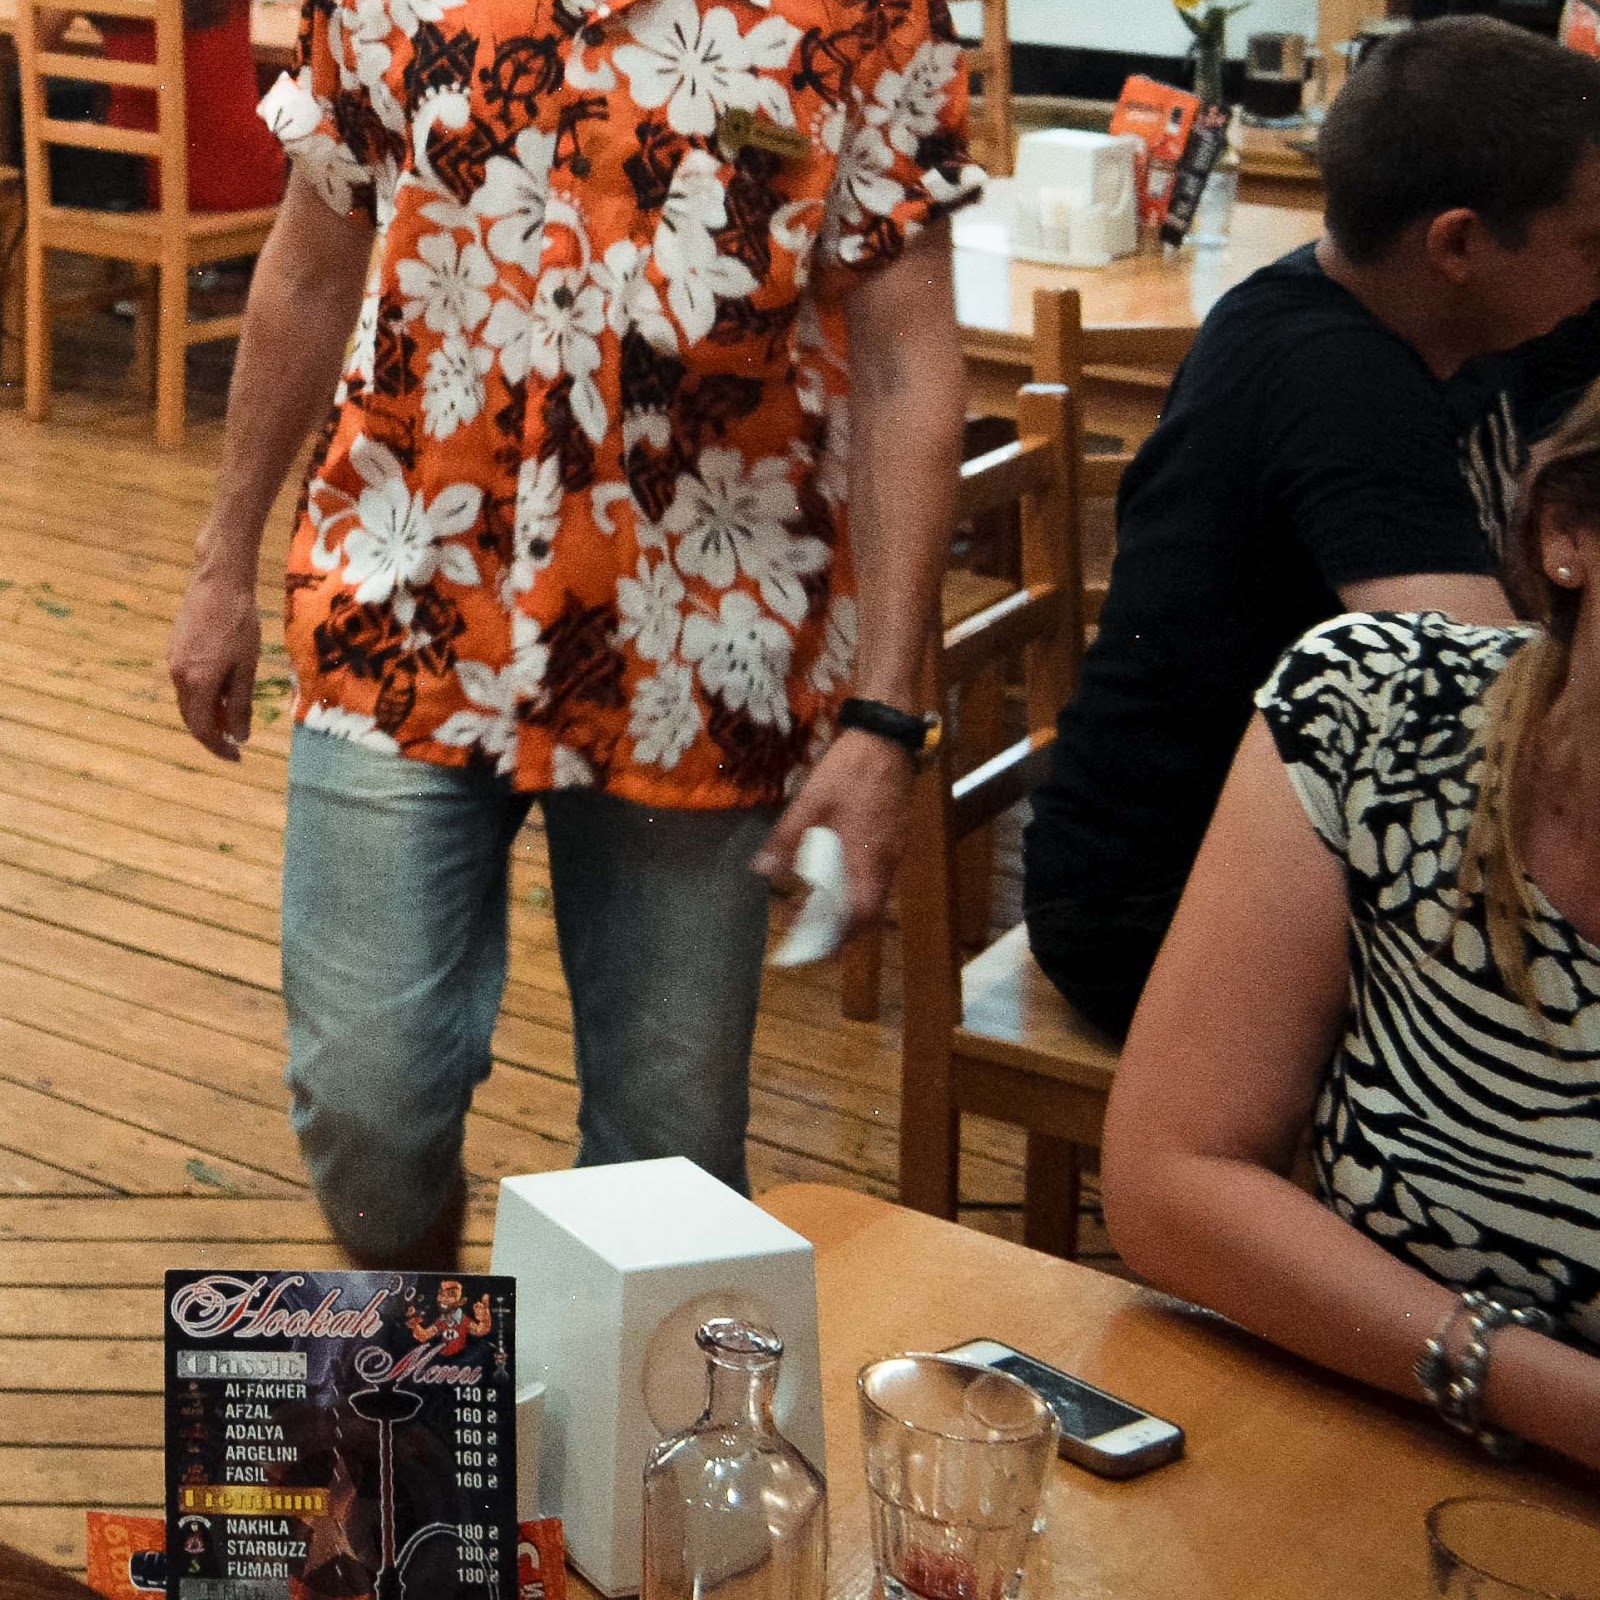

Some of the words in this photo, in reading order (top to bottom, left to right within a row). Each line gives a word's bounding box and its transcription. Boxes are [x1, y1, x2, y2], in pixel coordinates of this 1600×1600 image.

[171, 1275, 383, 1338] Hookah
[184, 1353, 302, 1377] Classic
[355, 1343, 482, 1385] Menu
[454, 1386, 481, 1402] 140
[225, 1404, 273, 1420] AFZAL
[454, 1407, 482, 1424] 160
[225, 1424, 284, 1441] ADALYA
[454, 1429, 482, 1445] 160
[225, 1445, 298, 1462] ARGELINI
[455, 1451, 482, 1466] 160
[226, 1466, 268, 1482] FASIL
[455, 1472, 482, 1488] 160
[184, 1489, 323, 1511] Premium
[226, 1518, 289, 1535] NAKHLA
[456, 1523, 483, 1540] 180
[227, 1540, 307, 1557] STARBUZZ
[456, 1545, 483, 1561] 180
[227, 1561, 289, 1578] FUMARI
[456, 1567, 484, 1583] 180
